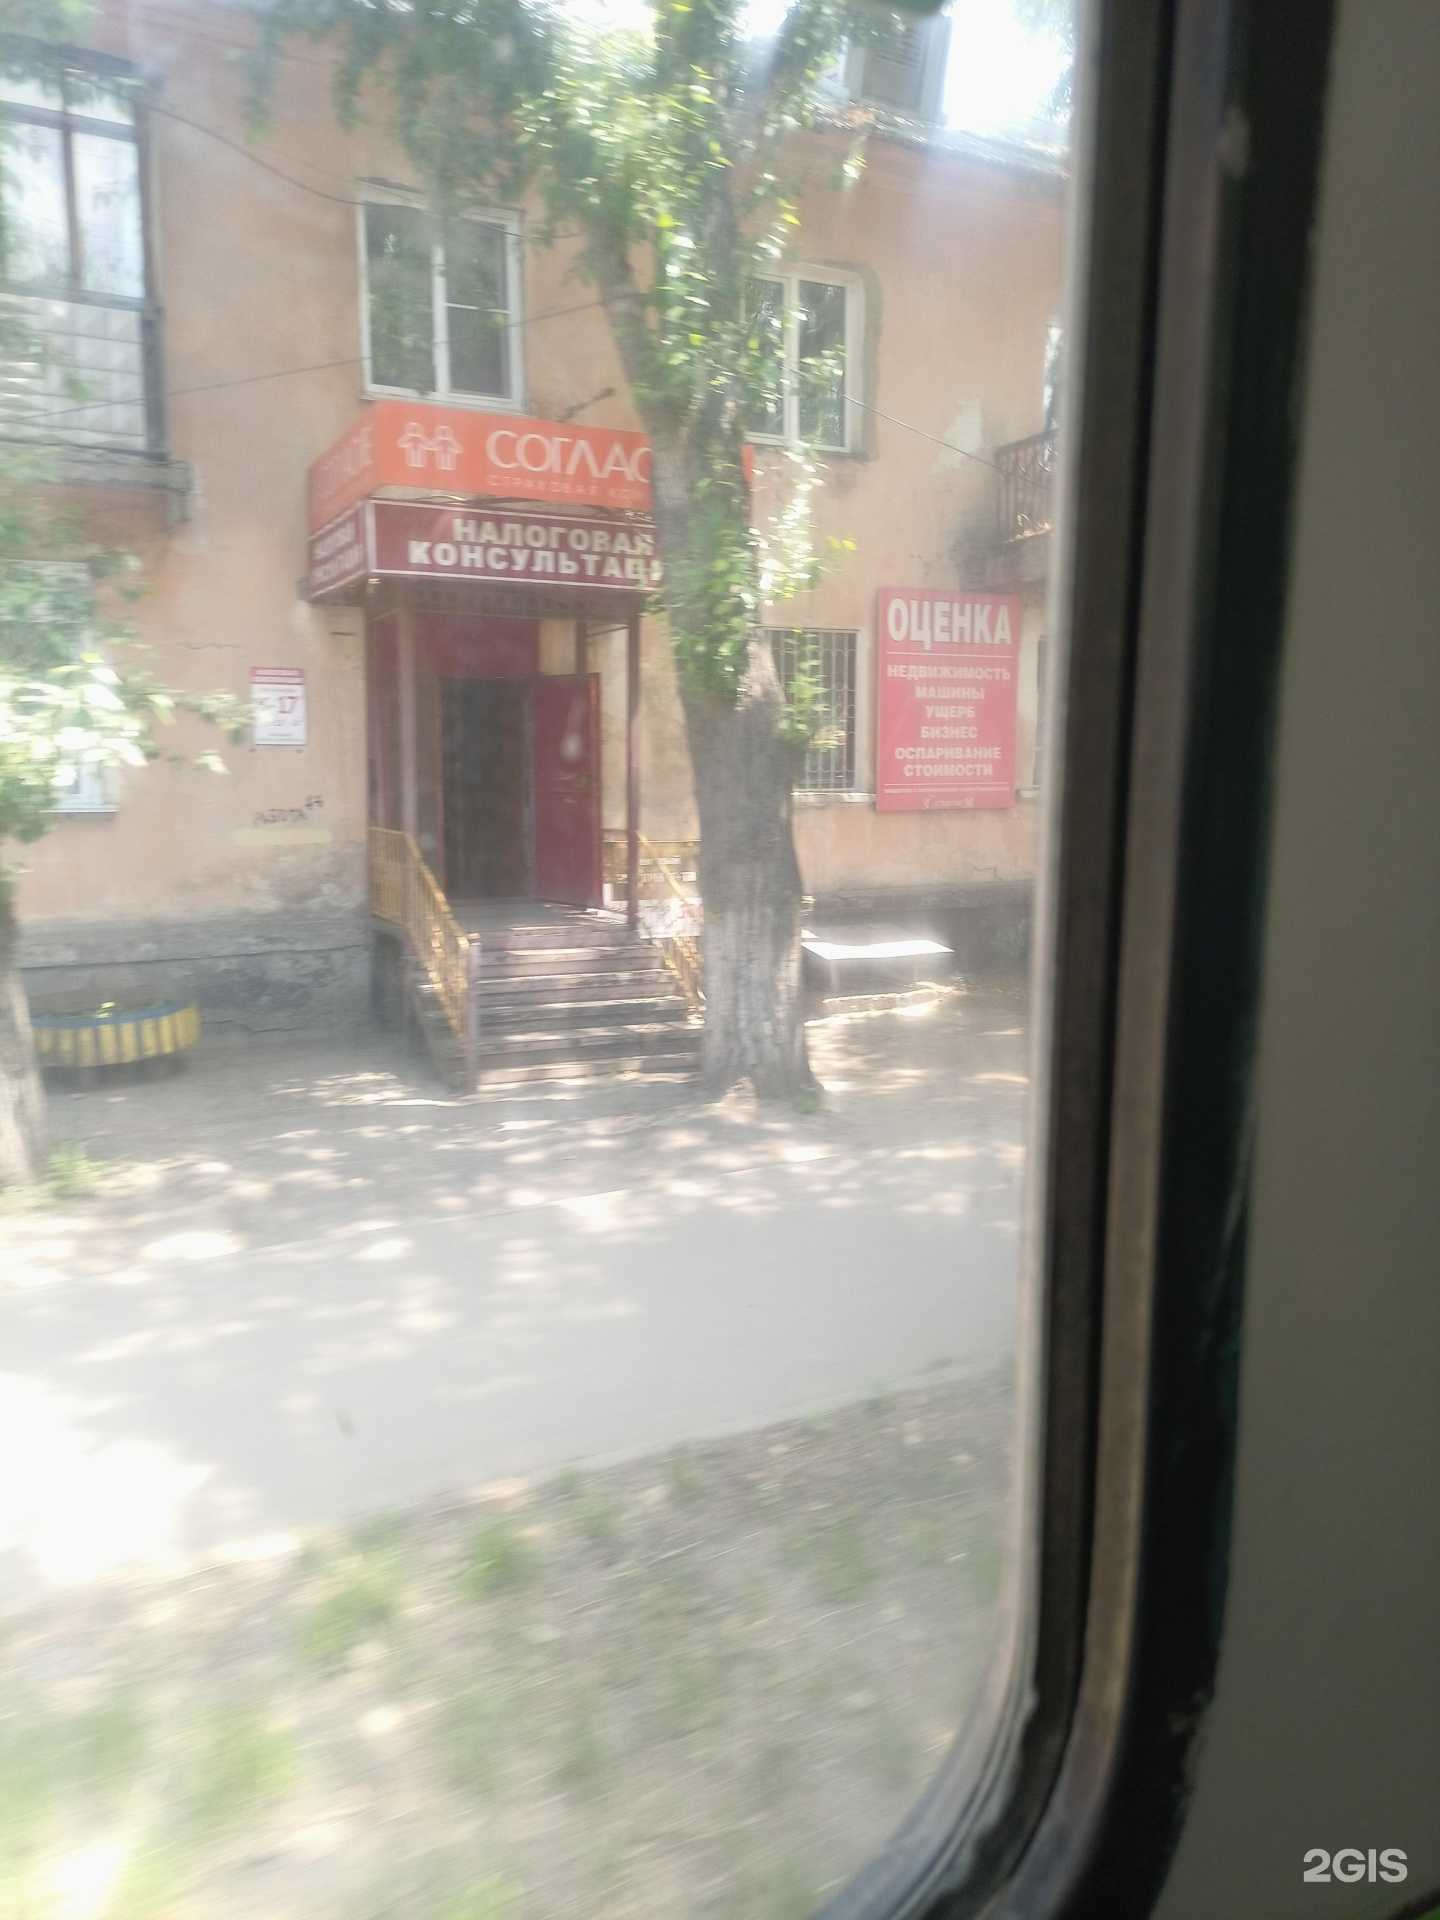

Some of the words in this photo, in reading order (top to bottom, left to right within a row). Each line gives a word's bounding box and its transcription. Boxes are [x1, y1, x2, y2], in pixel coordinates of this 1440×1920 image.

[888, 597, 1012, 650] ОЦЕНКА
[887, 664, 1010, 681] НЕДВИЖИМОСТЬ
[915, 685, 984, 700] МАШИНЫ
[925, 705, 975, 721] УЩЕРБ
[921, 725, 978, 739] БИЗНЕС
[895, 746, 1001, 760] ОСПАРИВАНИЕ
[903, 763, 992, 777] СТОИМОСТИ
